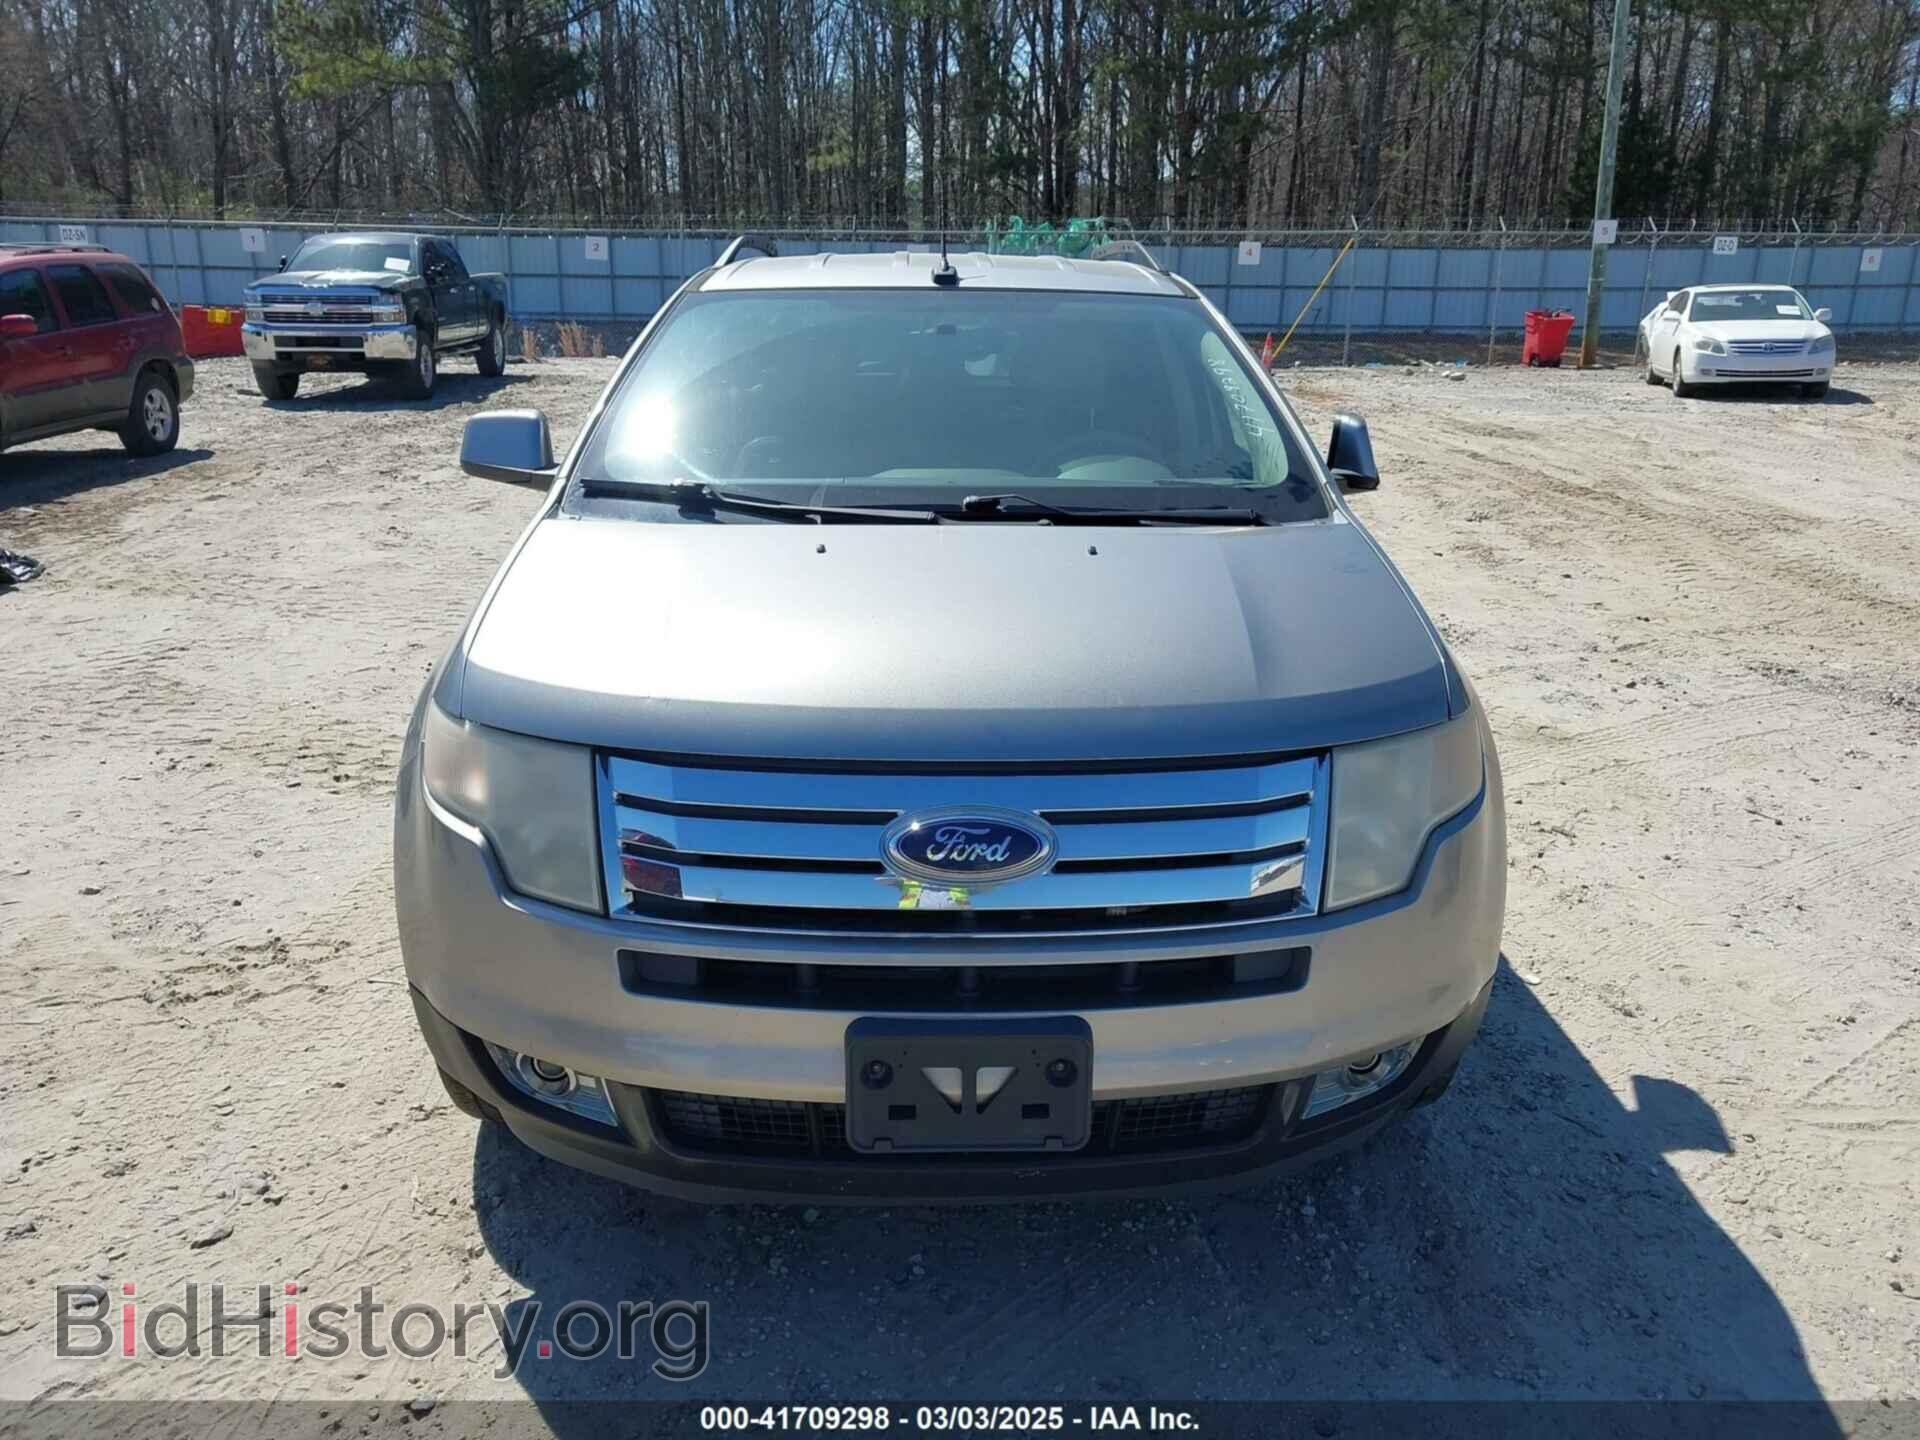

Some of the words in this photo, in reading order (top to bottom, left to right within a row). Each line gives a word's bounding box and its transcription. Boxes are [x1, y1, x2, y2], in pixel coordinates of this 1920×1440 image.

[592, 242, 600, 252] 2
[1245, 247, 1253, 257] 4
[926, 826, 1012, 862] Ford
